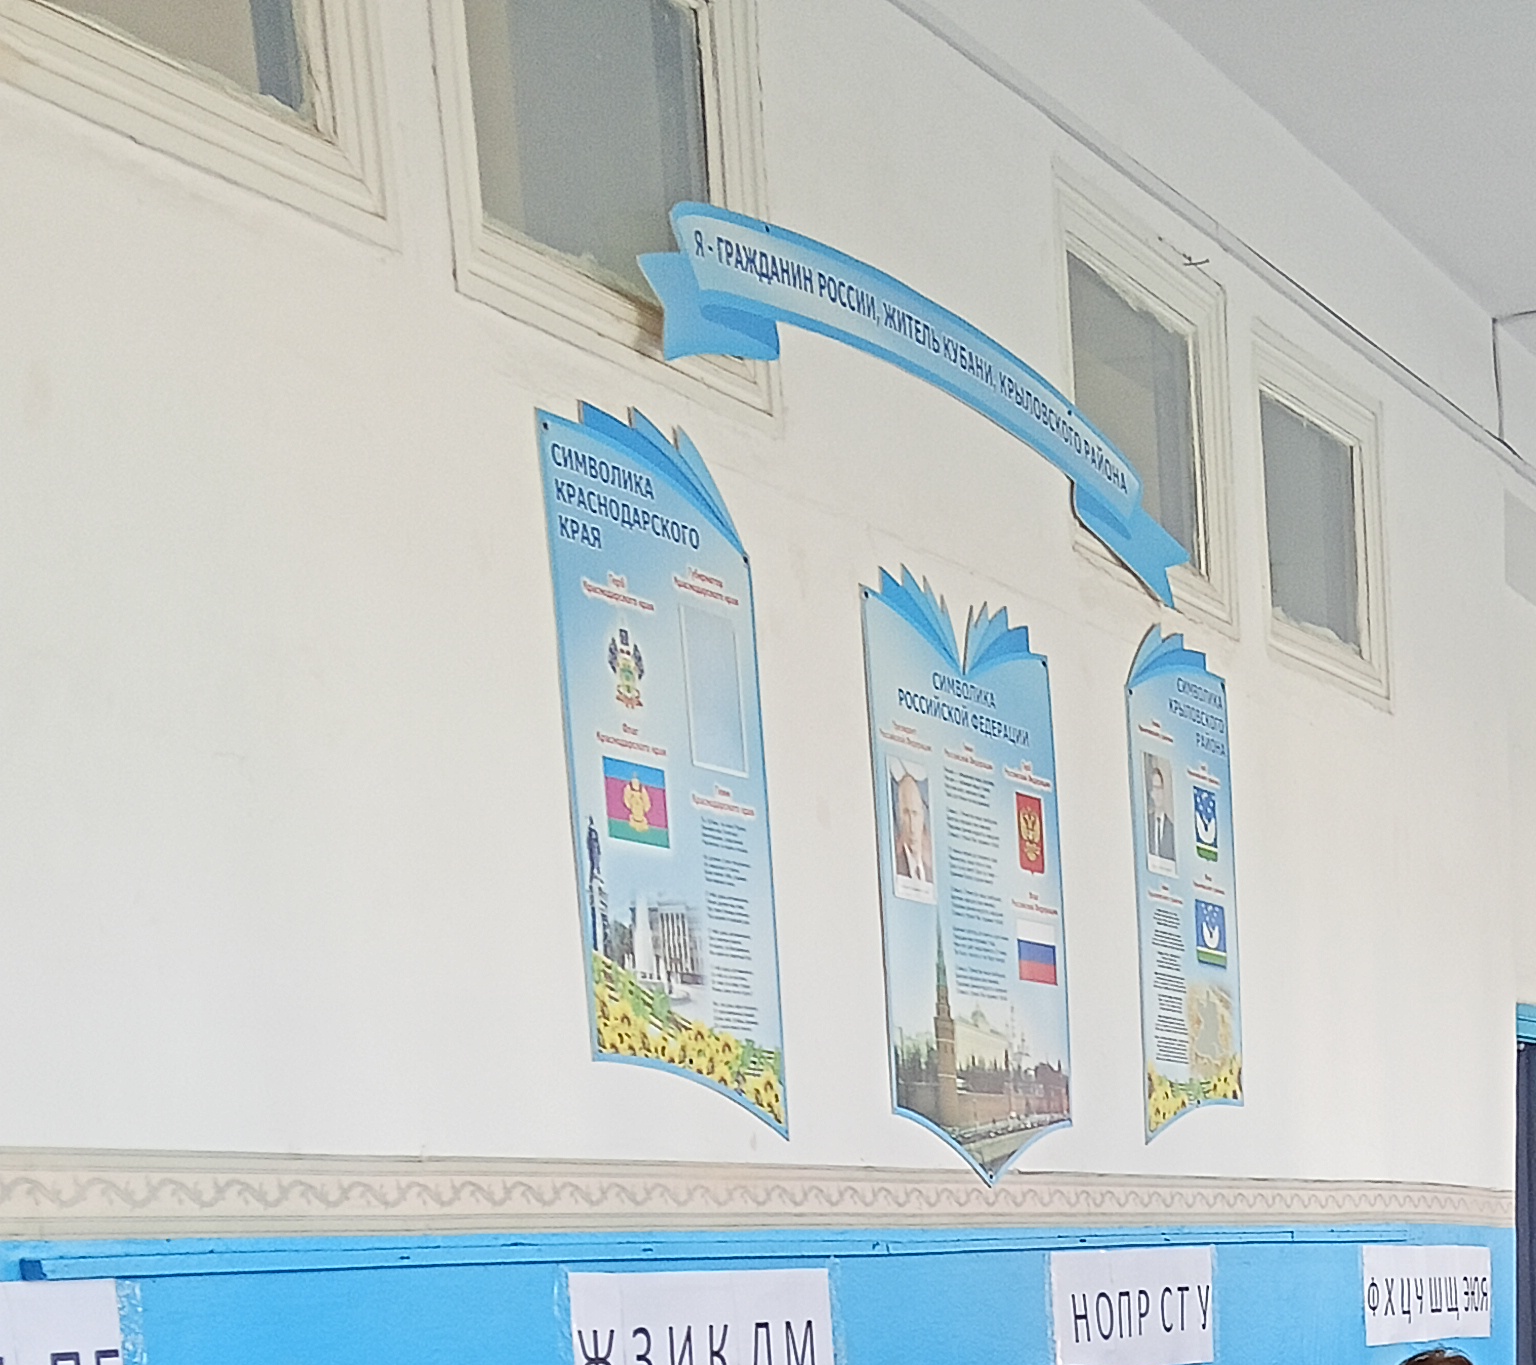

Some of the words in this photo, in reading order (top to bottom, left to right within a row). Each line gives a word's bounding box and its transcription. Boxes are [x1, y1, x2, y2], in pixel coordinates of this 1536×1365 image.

[694, 230, 705, 257] Я
[716, 236, 814, 294] ГРАЖДАНИН
[817, 272, 881, 327] РОССИИ,
[882, 302, 941, 354] ЖИТЕЛЬ
[942, 335, 997, 393] КУБАНИ,
[998, 371, 1083, 454] КРЫЛОВСКОГО
[1083, 439, 1128, 494] РАЙОНА
[551, 443, 655, 500] СИМВОЛИКА
[554, 478, 700, 550] КРАСНОДАРСКОГО
[558, 514, 602, 549] КРАЯ
[897, 688, 970, 728] РОССИЙСКОЙ
[970, 713, 1030, 747] ФЕДЕРАЦИИ
[932, 672, 996, 709] СИМВОЛИКА
